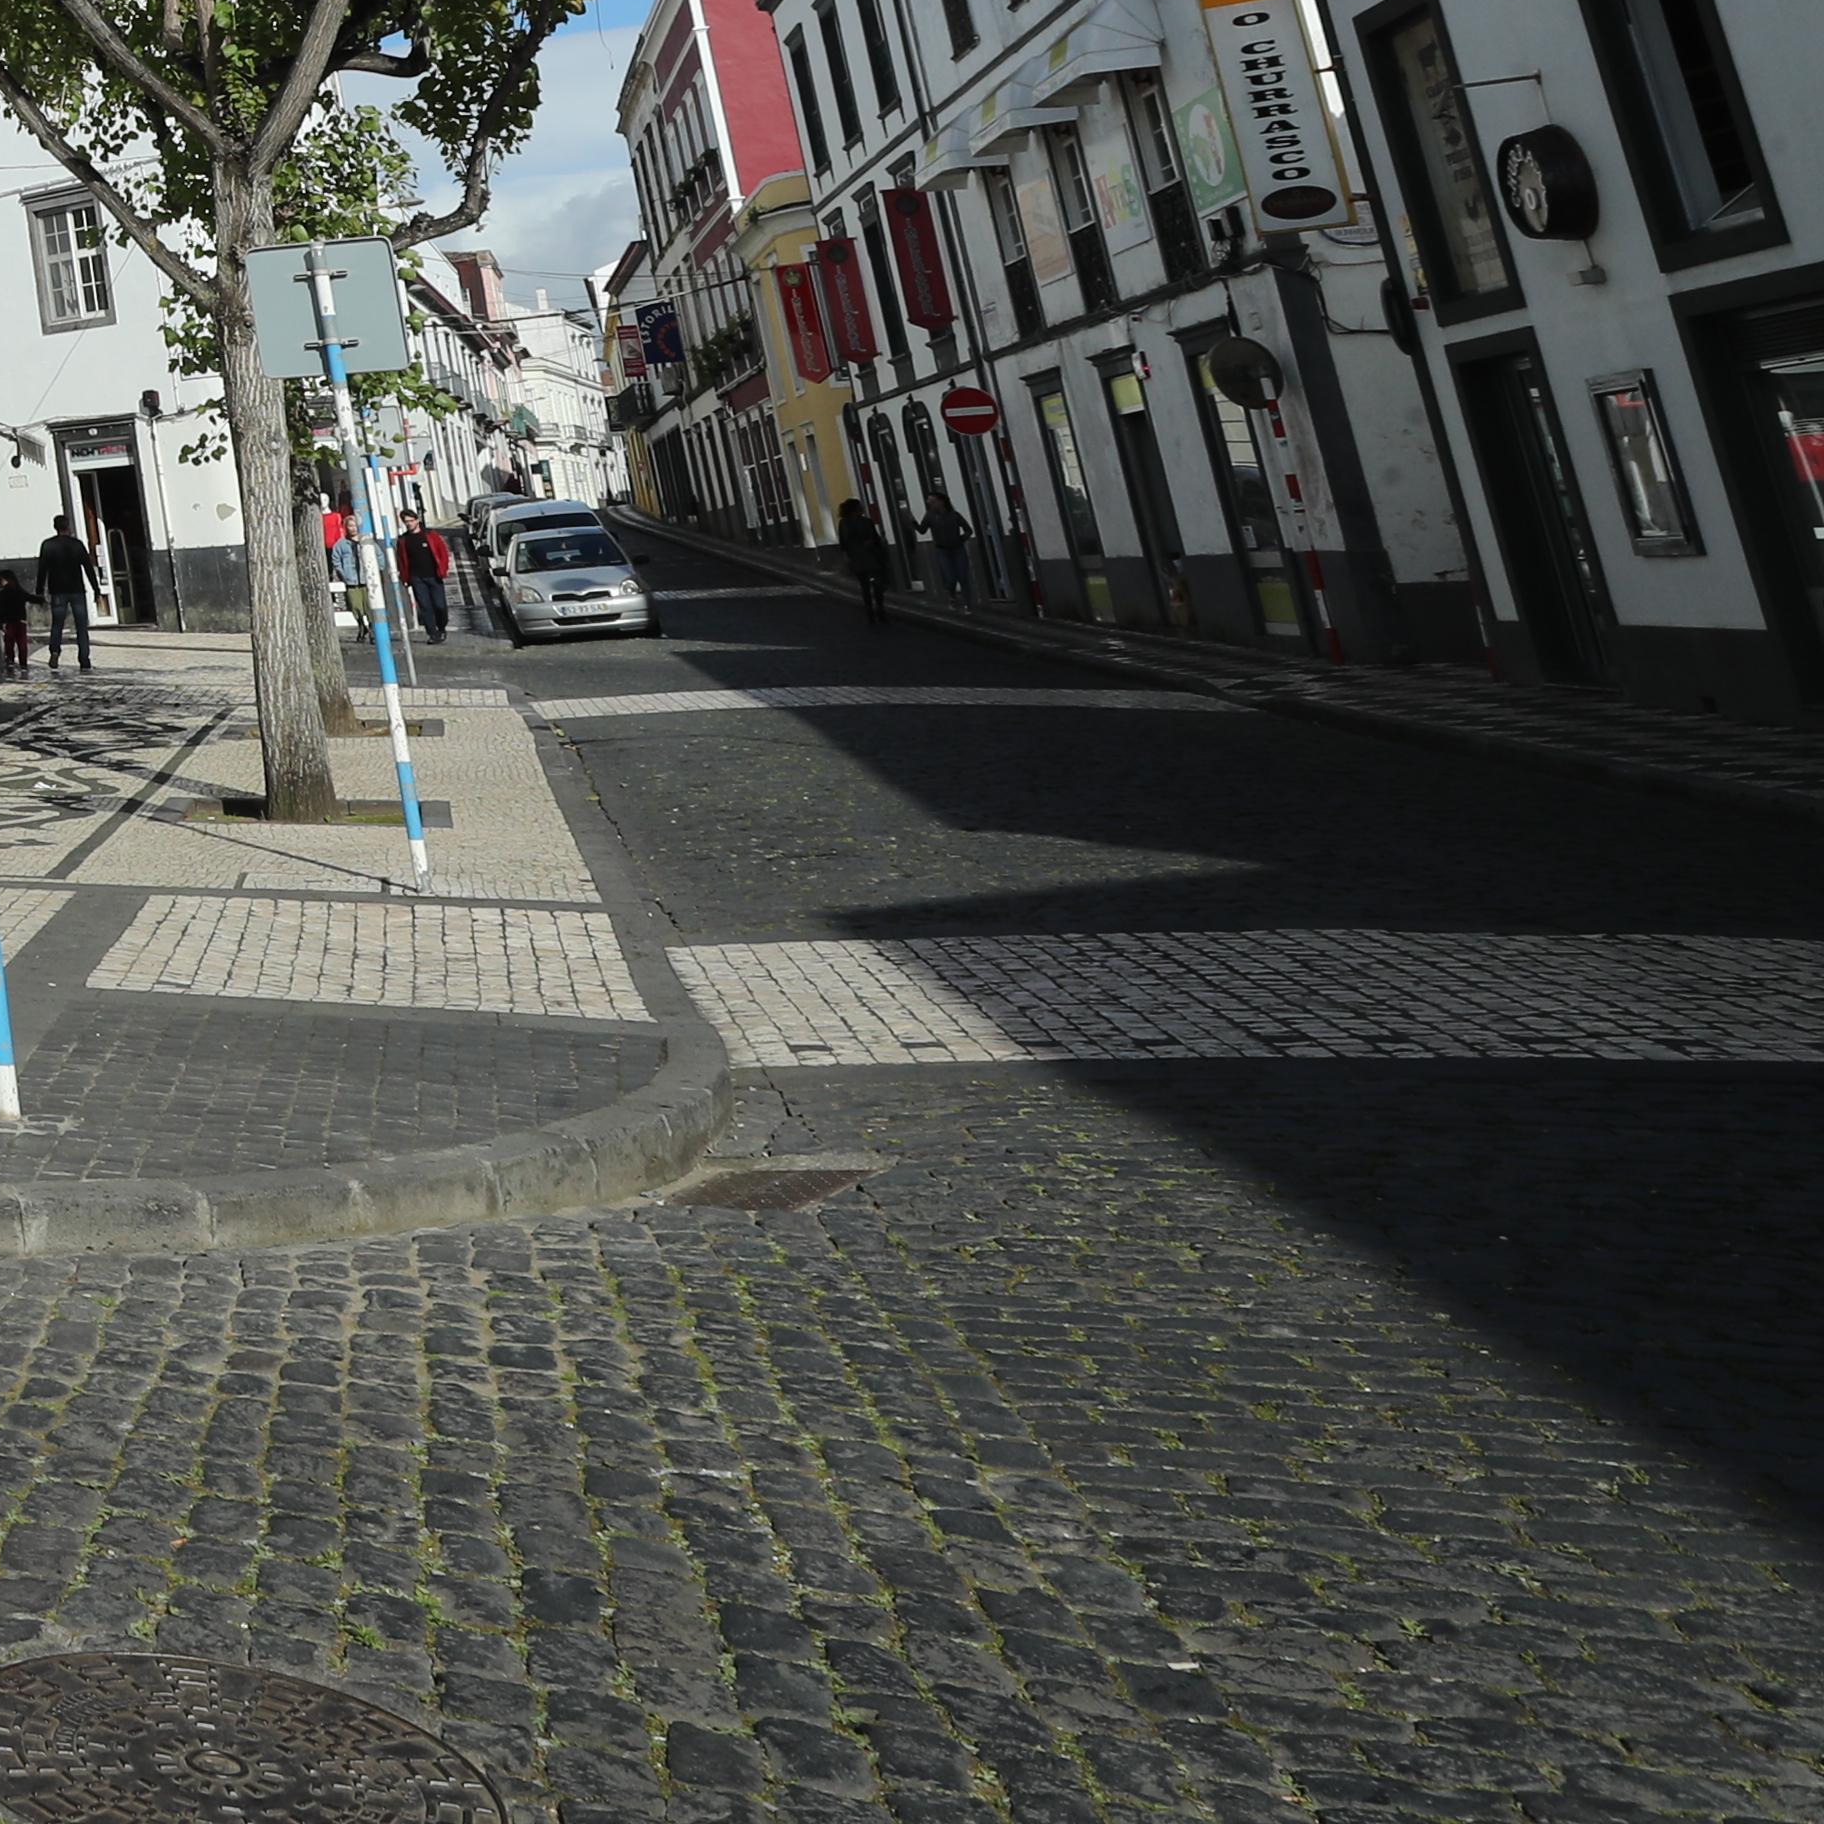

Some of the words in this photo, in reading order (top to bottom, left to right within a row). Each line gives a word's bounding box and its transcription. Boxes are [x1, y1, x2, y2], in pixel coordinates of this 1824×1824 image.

[1232, 12, 1270, 27] O
[1239, 40, 1311, 181] CHURRASCO
[640, 304, 675, 344] ESTORIL
